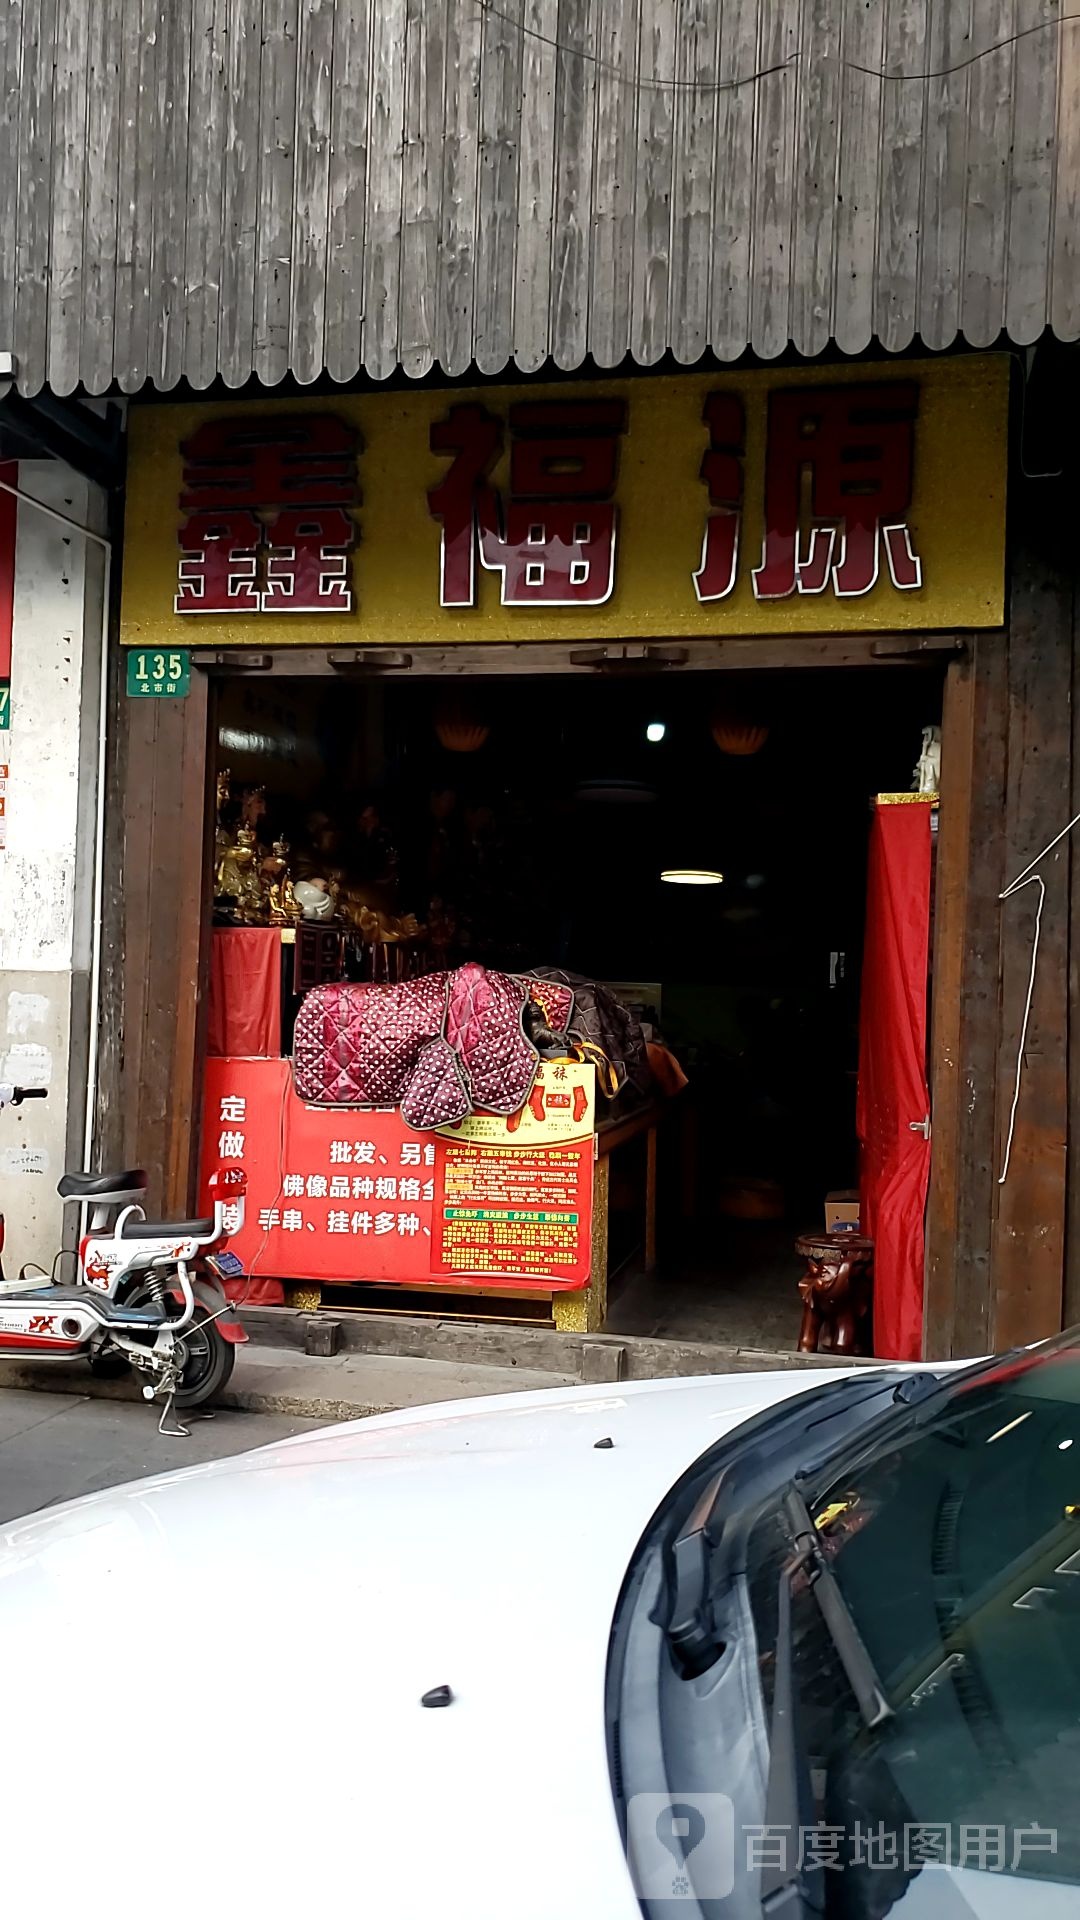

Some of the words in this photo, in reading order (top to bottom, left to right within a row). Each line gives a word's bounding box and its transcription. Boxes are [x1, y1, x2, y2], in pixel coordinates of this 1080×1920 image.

[175, 381, 922, 614] 鑫福源
[136, 654, 182, 680] 135
[140, 682, 176, 693] 北市街
[219, 1095, 246, 1235] 定做装
